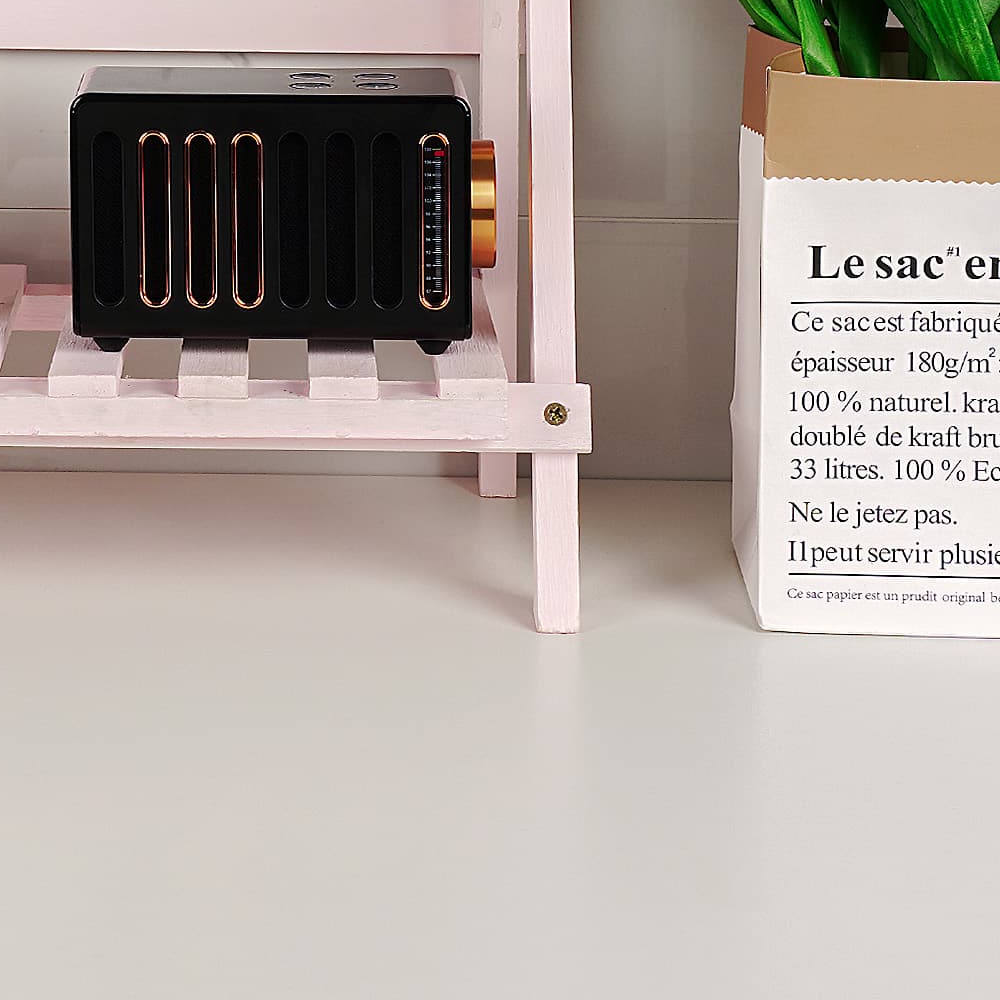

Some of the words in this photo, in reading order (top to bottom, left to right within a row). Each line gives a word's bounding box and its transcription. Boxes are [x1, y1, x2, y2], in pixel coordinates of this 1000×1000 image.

[808, 245, 864, 279] Le
[792, 311, 823, 332] Ce
[791, 351, 895, 378] épaisseur
[790, 391, 829, 412] 100
[838, 391, 861, 412] %
[869, 392, 956, 412] naturel.
[963, 392, 1000, 413] kra
[791, 425, 866, 446] doublé
[876, 425, 903, 446] de
[908, 426, 961, 447] kraft
[790, 459, 816, 479] 33
[824, 458, 883, 479] litres.
[896, 459, 933, 480] 100
[941, 460, 965, 481] %
[972, 461, 1000, 481] Ec
[788, 502, 822, 522] Ne
[830, 501, 848, 522] le
[852, 502, 908, 529] jetez
[914, 509, 957, 529] pas.
[811, 544, 863, 567] peut
[868, 542, 933, 563] servir
[787, 588, 803, 598] Ce
[827, 589, 862, 602] papier
[865, 592, 880, 600] est
[942, 592, 985, 605] original
